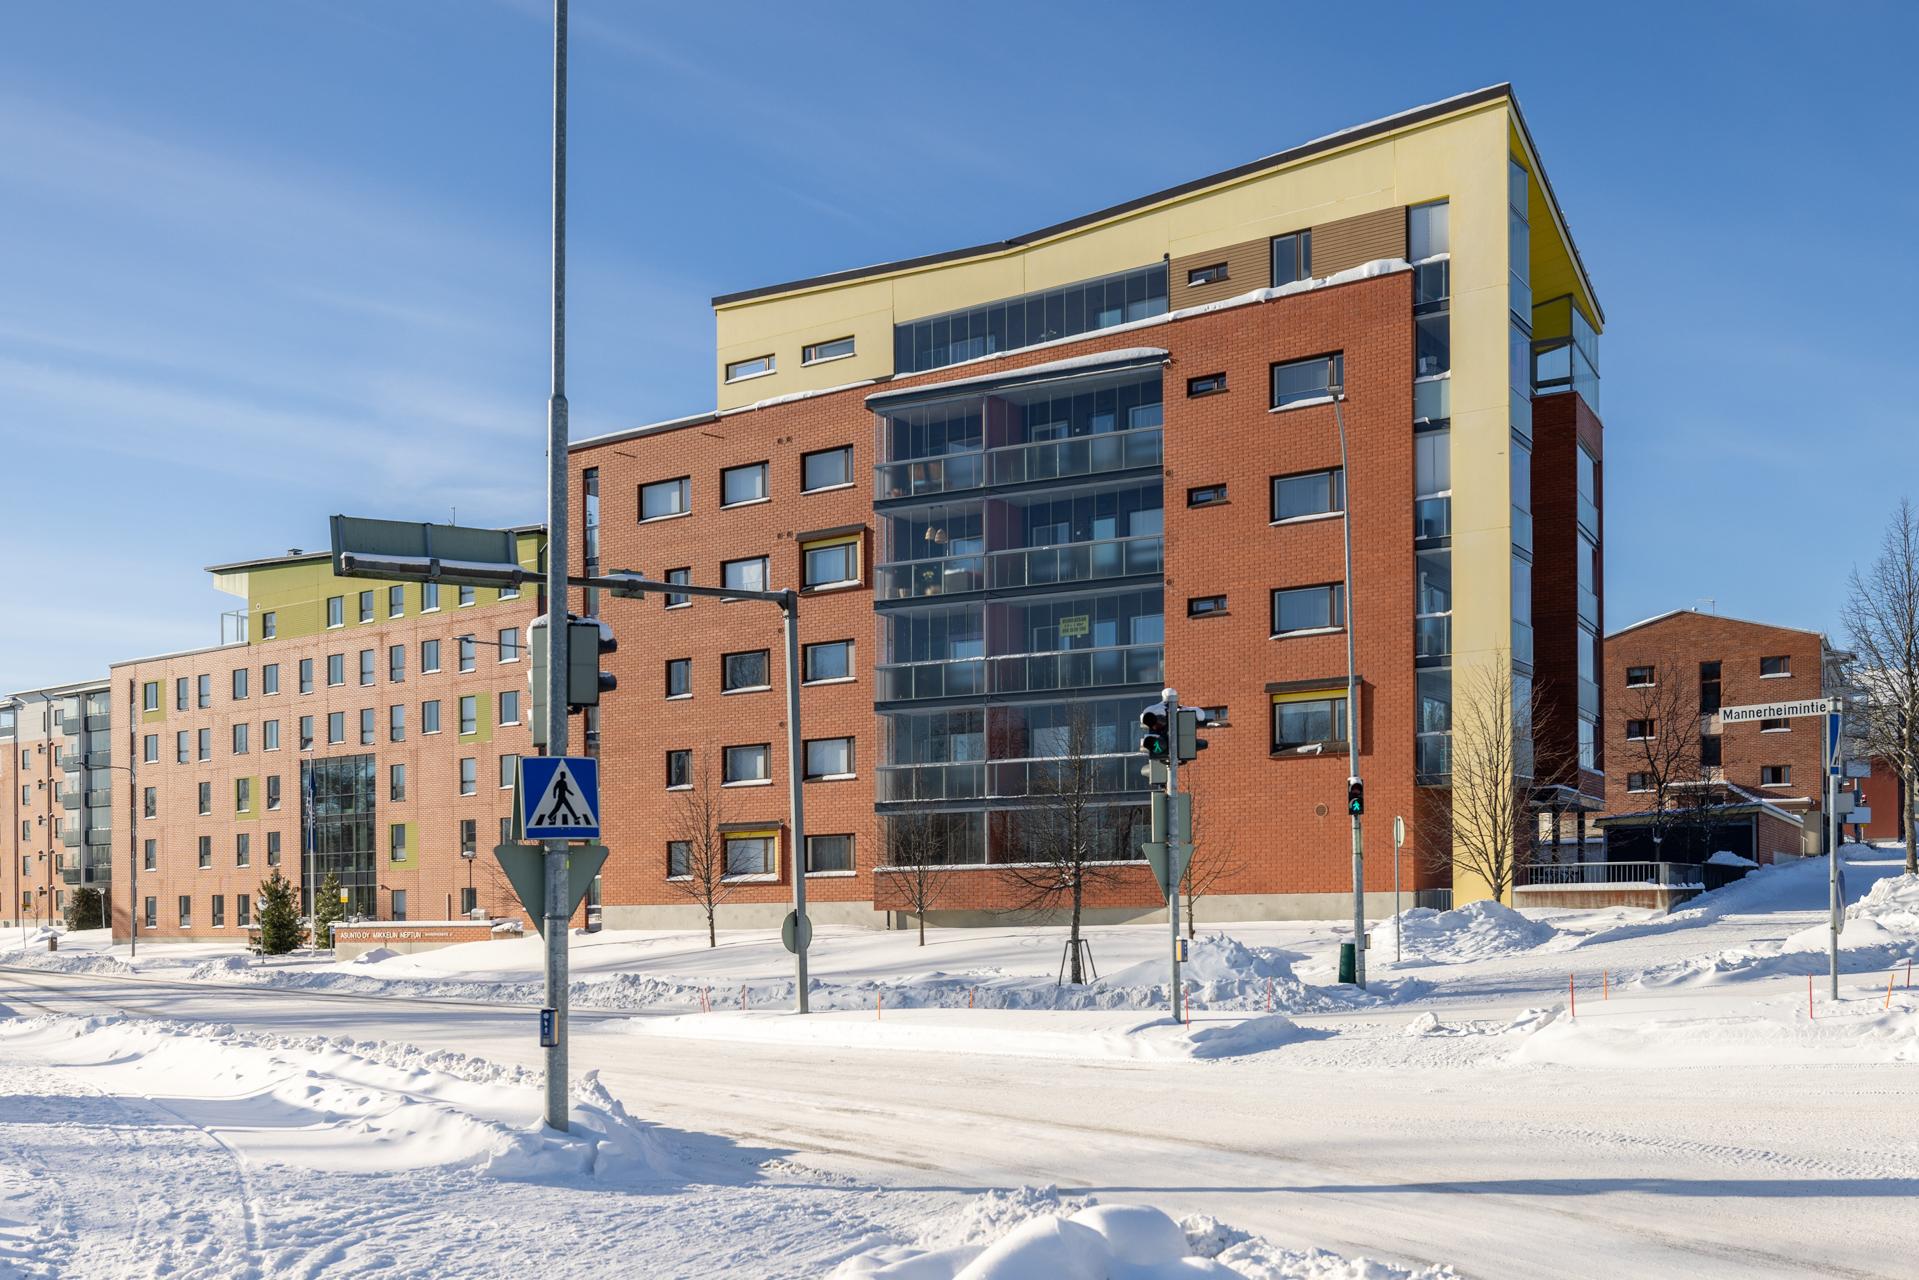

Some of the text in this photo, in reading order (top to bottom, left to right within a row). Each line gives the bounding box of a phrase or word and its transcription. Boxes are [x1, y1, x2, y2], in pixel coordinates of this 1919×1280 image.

[1723, 701, 1827, 721] Mannerheimintie
[340, 931, 361, 939] ASUNTO
[362, 931, 370, 939] OY
[399, 931, 422, 939] NEPTUN
